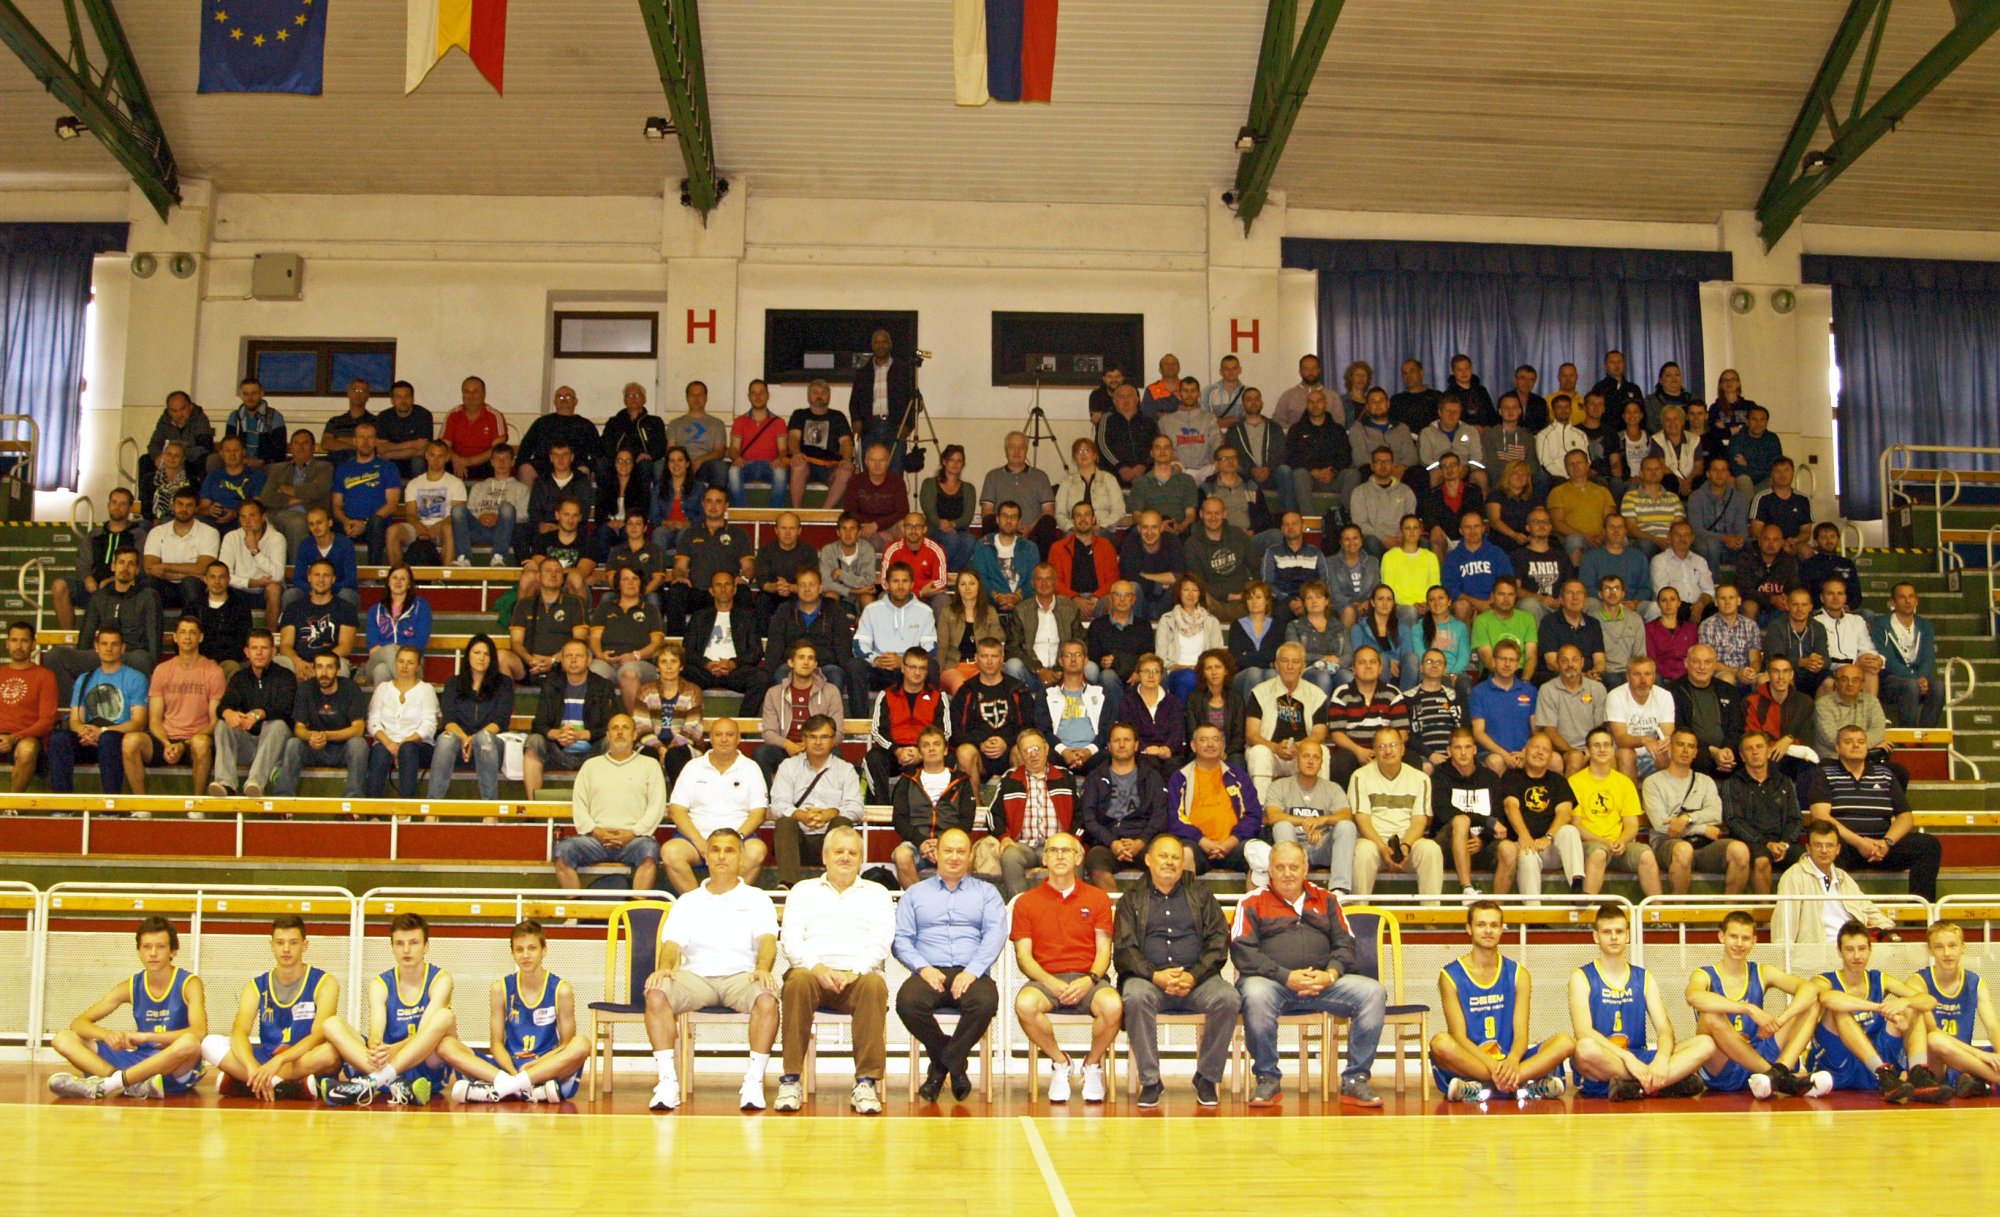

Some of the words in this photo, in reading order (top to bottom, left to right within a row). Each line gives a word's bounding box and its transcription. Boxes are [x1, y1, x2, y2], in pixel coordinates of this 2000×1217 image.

[687, 309, 716, 344] H
[1231, 319, 1259, 354] H
[1469, 994, 1504, 1006] DEEM
[1484, 1016, 1496, 1039] 9
[523, 1035, 536, 1052] 11
